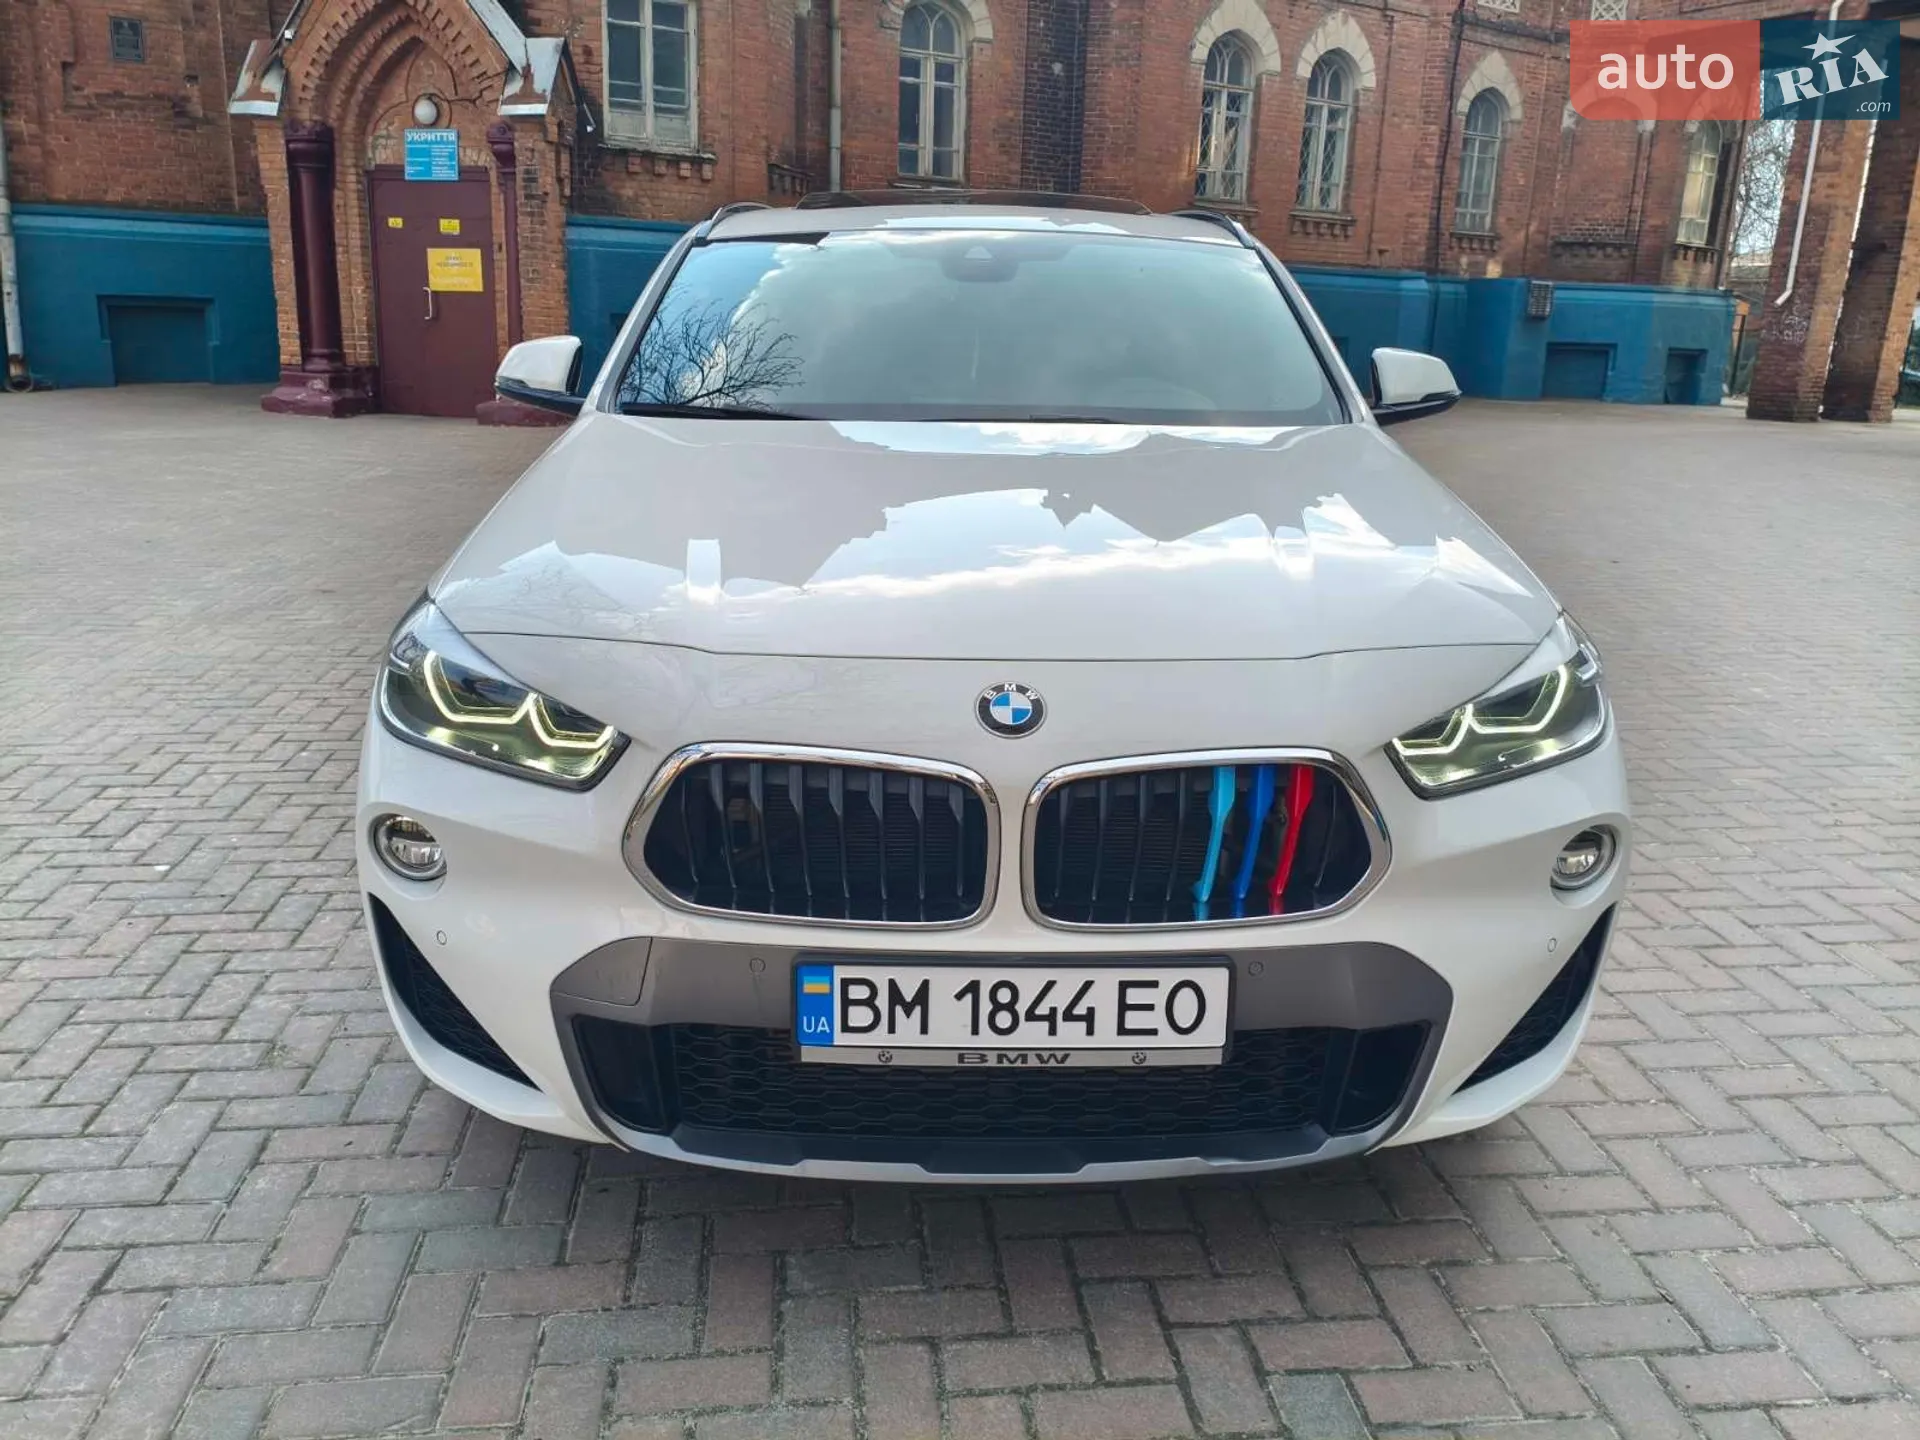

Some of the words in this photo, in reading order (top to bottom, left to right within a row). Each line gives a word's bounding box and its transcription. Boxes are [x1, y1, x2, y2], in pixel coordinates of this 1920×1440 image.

[406, 131, 455, 142] УКРИТТЯ
[983, 682, 1039, 700] BMW
[839, 977, 930, 1036] BM
[953, 979, 1096, 1037] 1844
[1116, 979, 1207, 1037] EO
[802, 1015, 831, 1034] UA
[957, 1052, 1071, 1065] BMW
